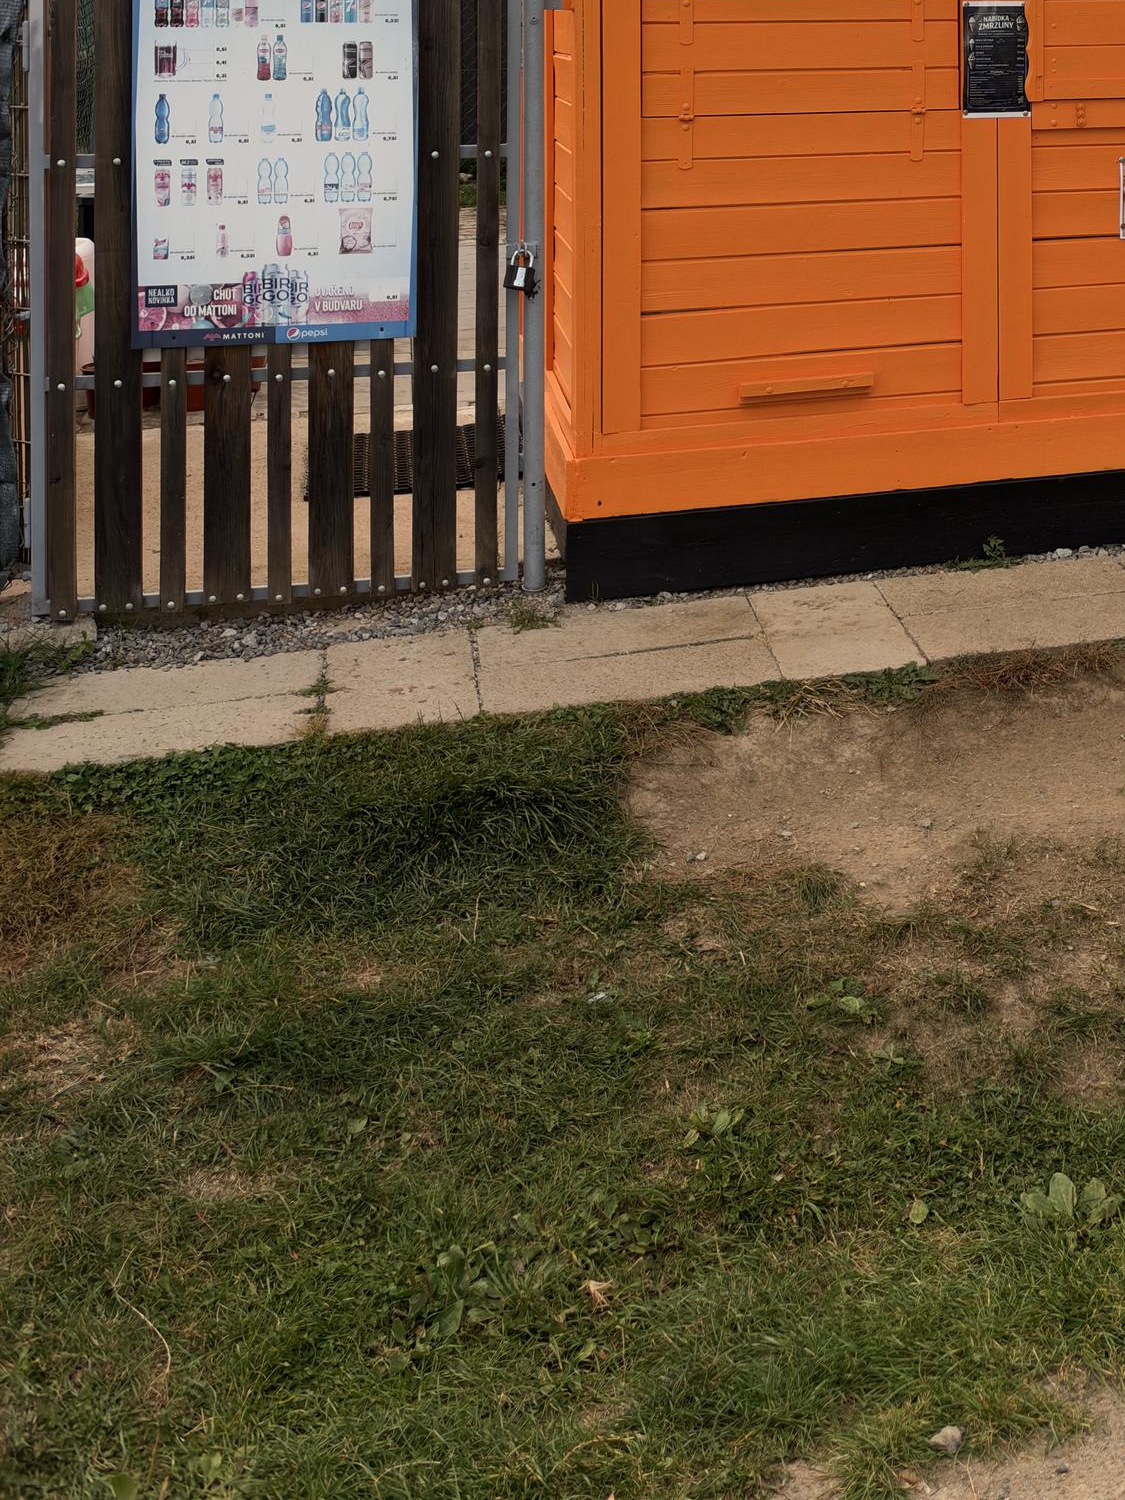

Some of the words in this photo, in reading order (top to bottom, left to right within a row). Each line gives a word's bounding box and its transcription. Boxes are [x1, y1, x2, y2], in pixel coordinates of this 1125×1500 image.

[978, 21, 1014, 30] ZMRZLINY
[263, 277, 290, 289] BIR
[148, 288, 175, 296] NEALKO
[263, 290, 289, 301] GO
[148, 296, 175, 304] NOVINKA
[184, 306, 196, 317] OD
[198, 304, 237, 316] MATTONI
[315, 303, 321, 313] V
[322, 300, 363, 312] BUDVARU
[301, 328, 328, 338] pepsi
